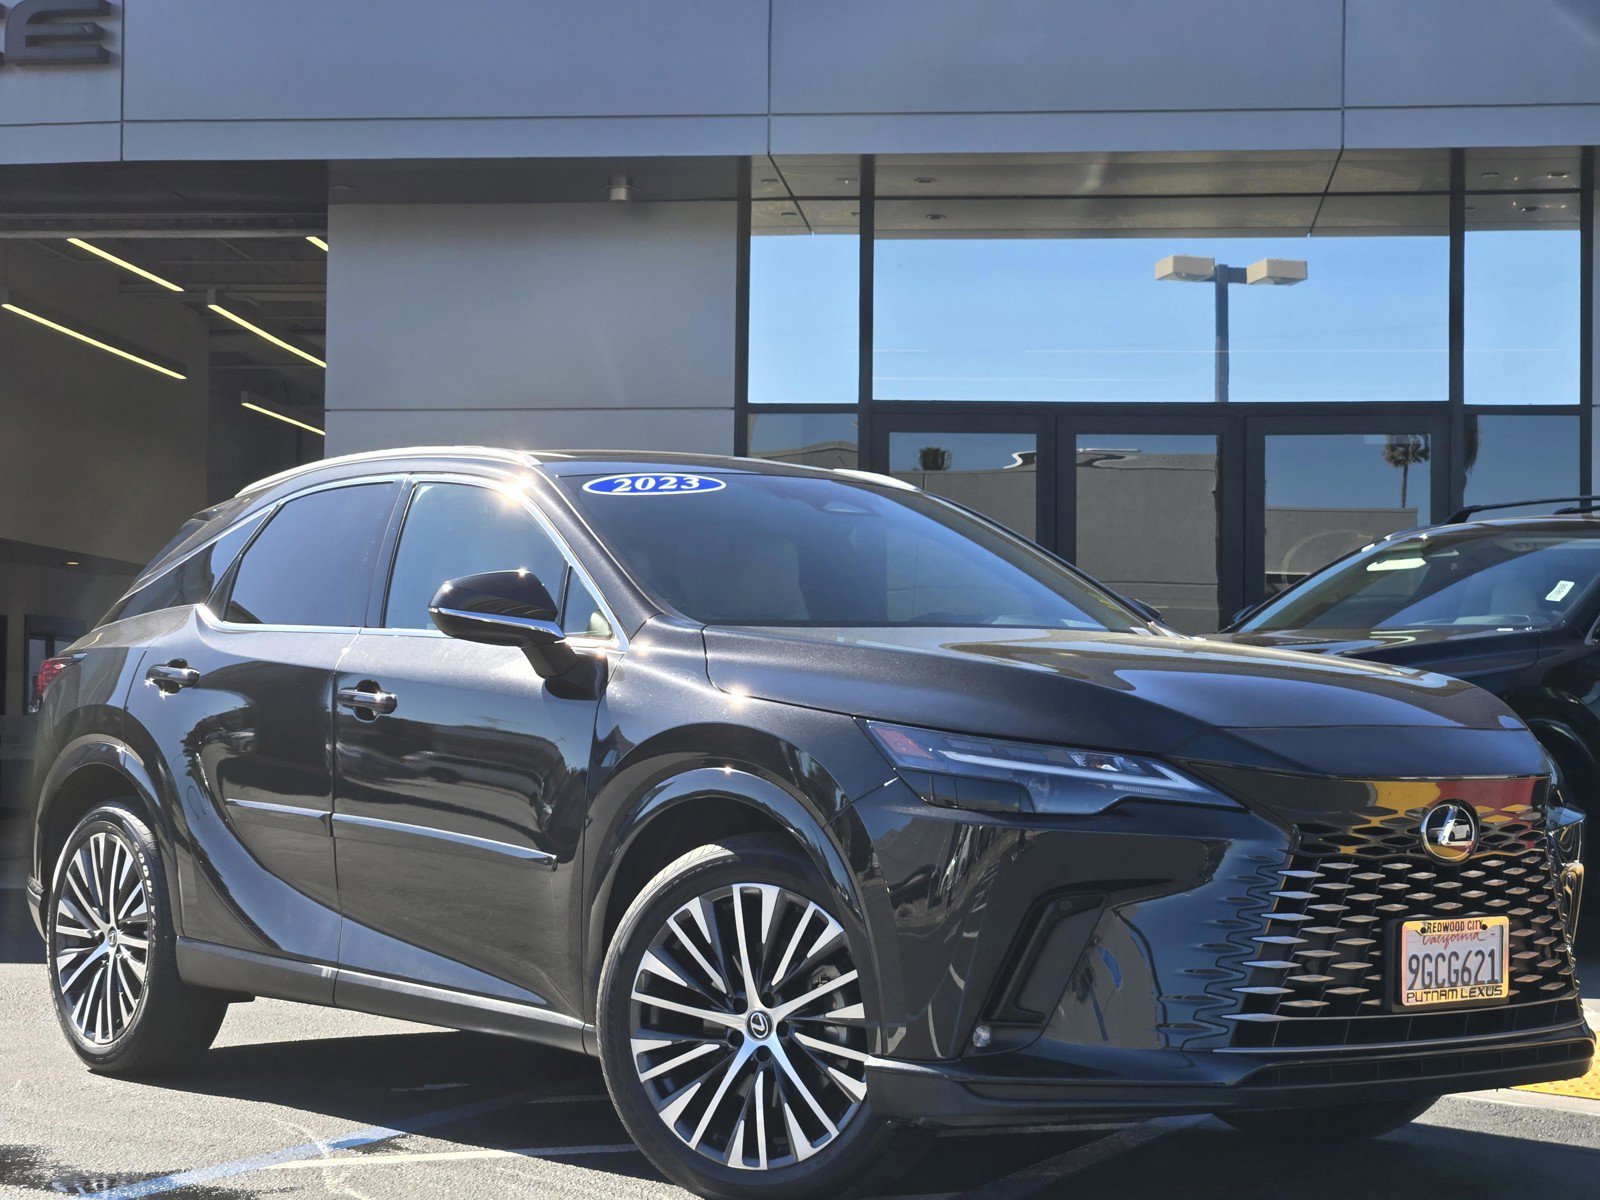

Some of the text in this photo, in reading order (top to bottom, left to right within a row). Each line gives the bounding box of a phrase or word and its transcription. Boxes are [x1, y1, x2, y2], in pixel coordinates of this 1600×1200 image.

[611, 476, 700, 493] 2023
[1427, 919, 1484, 933] REDWOOD CITY
[1407, 948, 1499, 991] 9GCG621
[1406, 984, 1503, 1003] PUTNAM LEXUS
